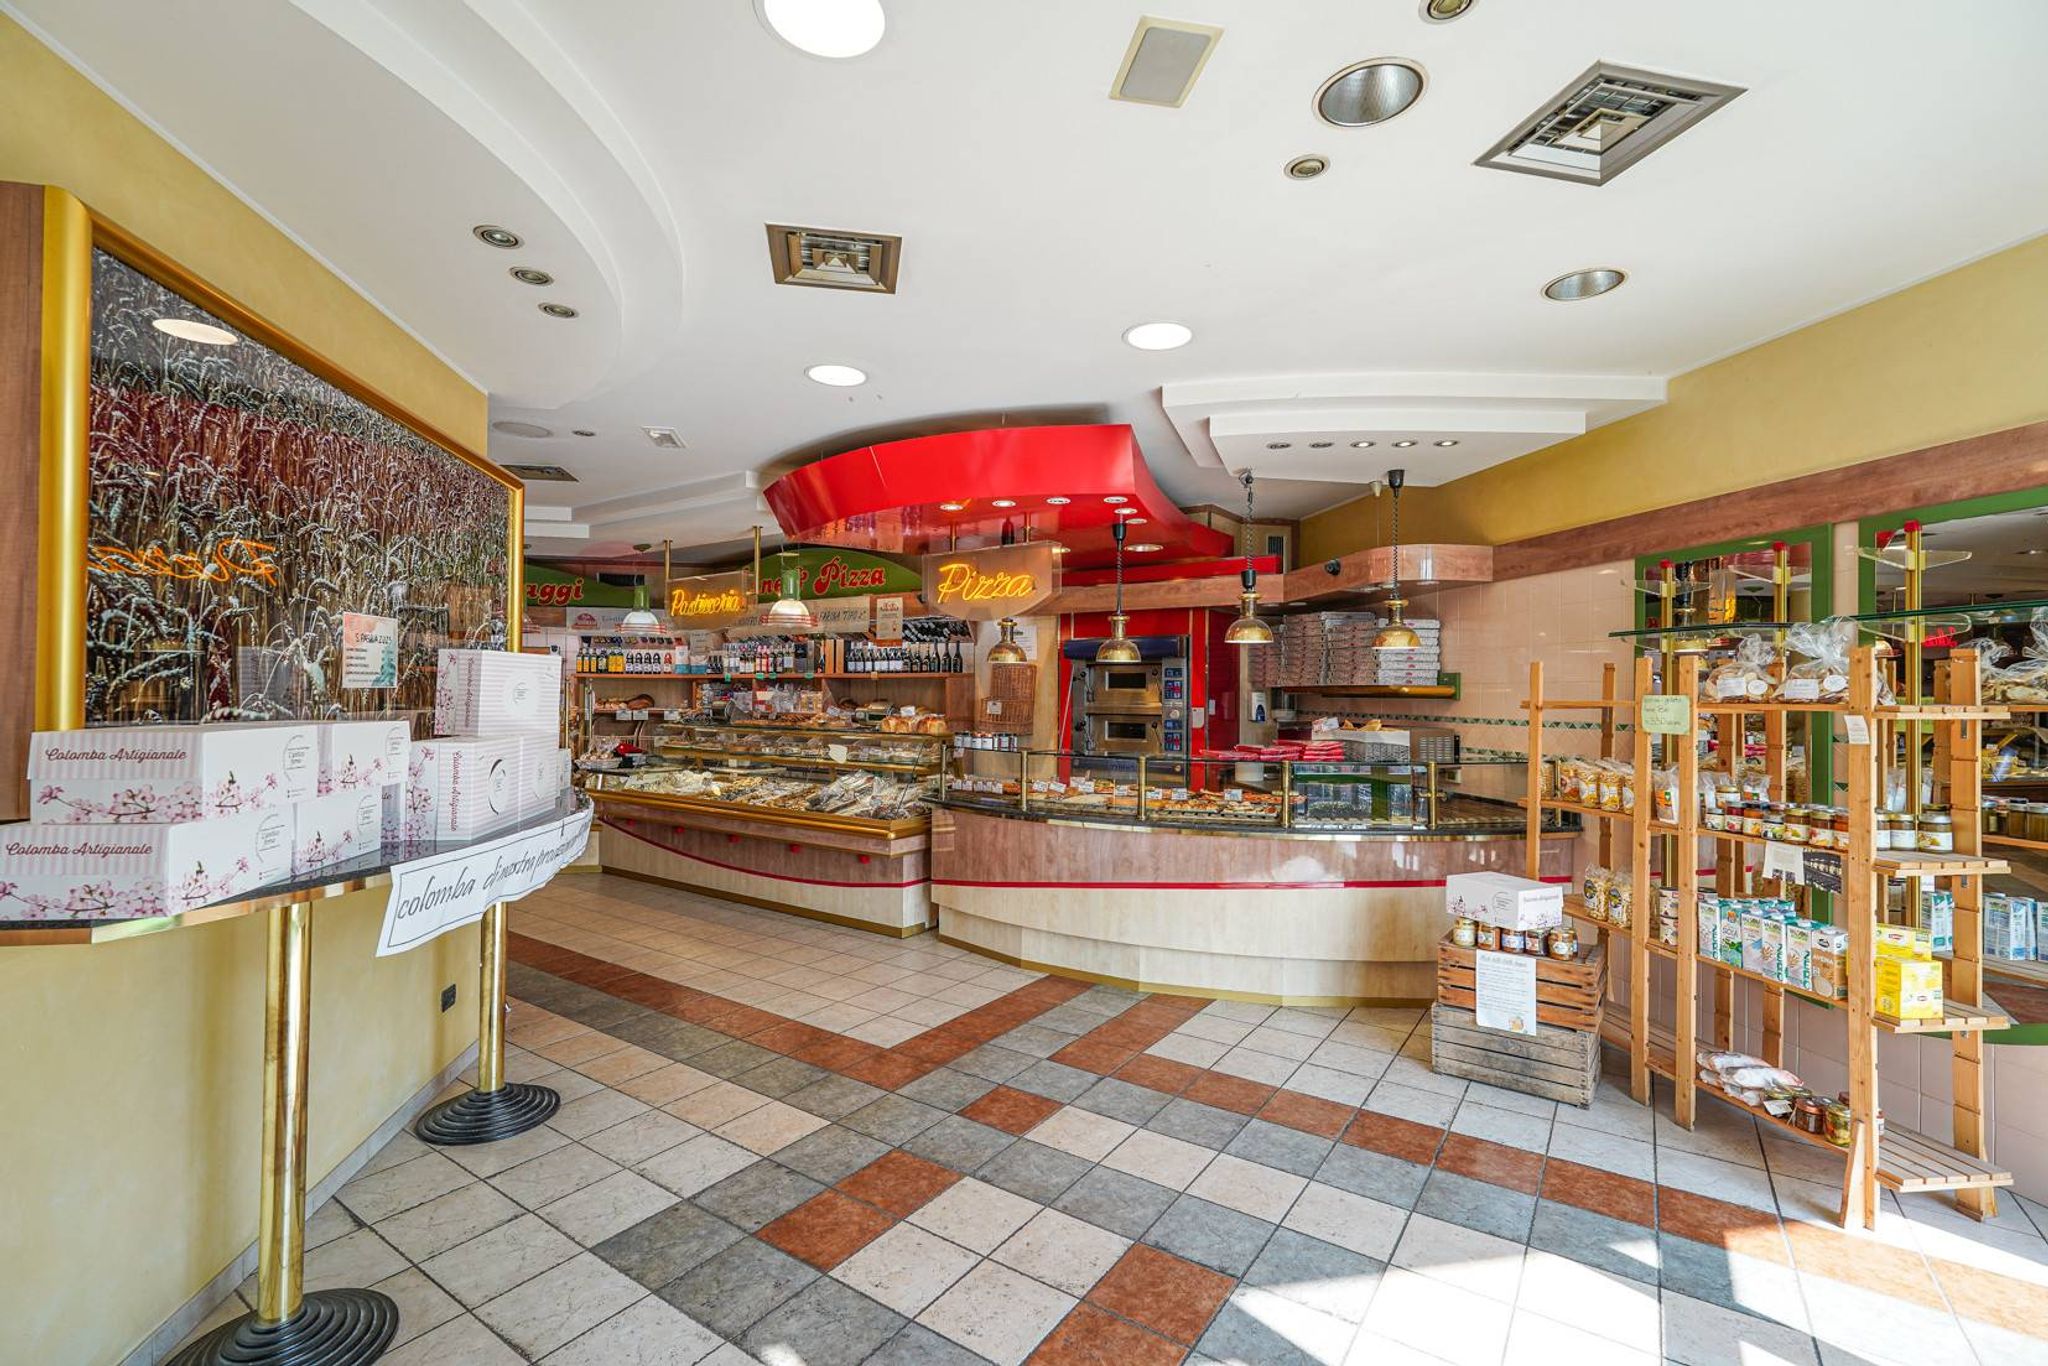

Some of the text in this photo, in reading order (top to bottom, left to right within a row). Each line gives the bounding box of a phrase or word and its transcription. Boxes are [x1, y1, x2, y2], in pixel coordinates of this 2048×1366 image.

[813, 555, 886, 595] Pizza
[937, 563, 1034, 604] Pizza
[45, 748, 187, 764] Colomba Artigianale
[6, 842, 153, 858] Colomba Artigianale
[397, 866, 476, 919] colomba
